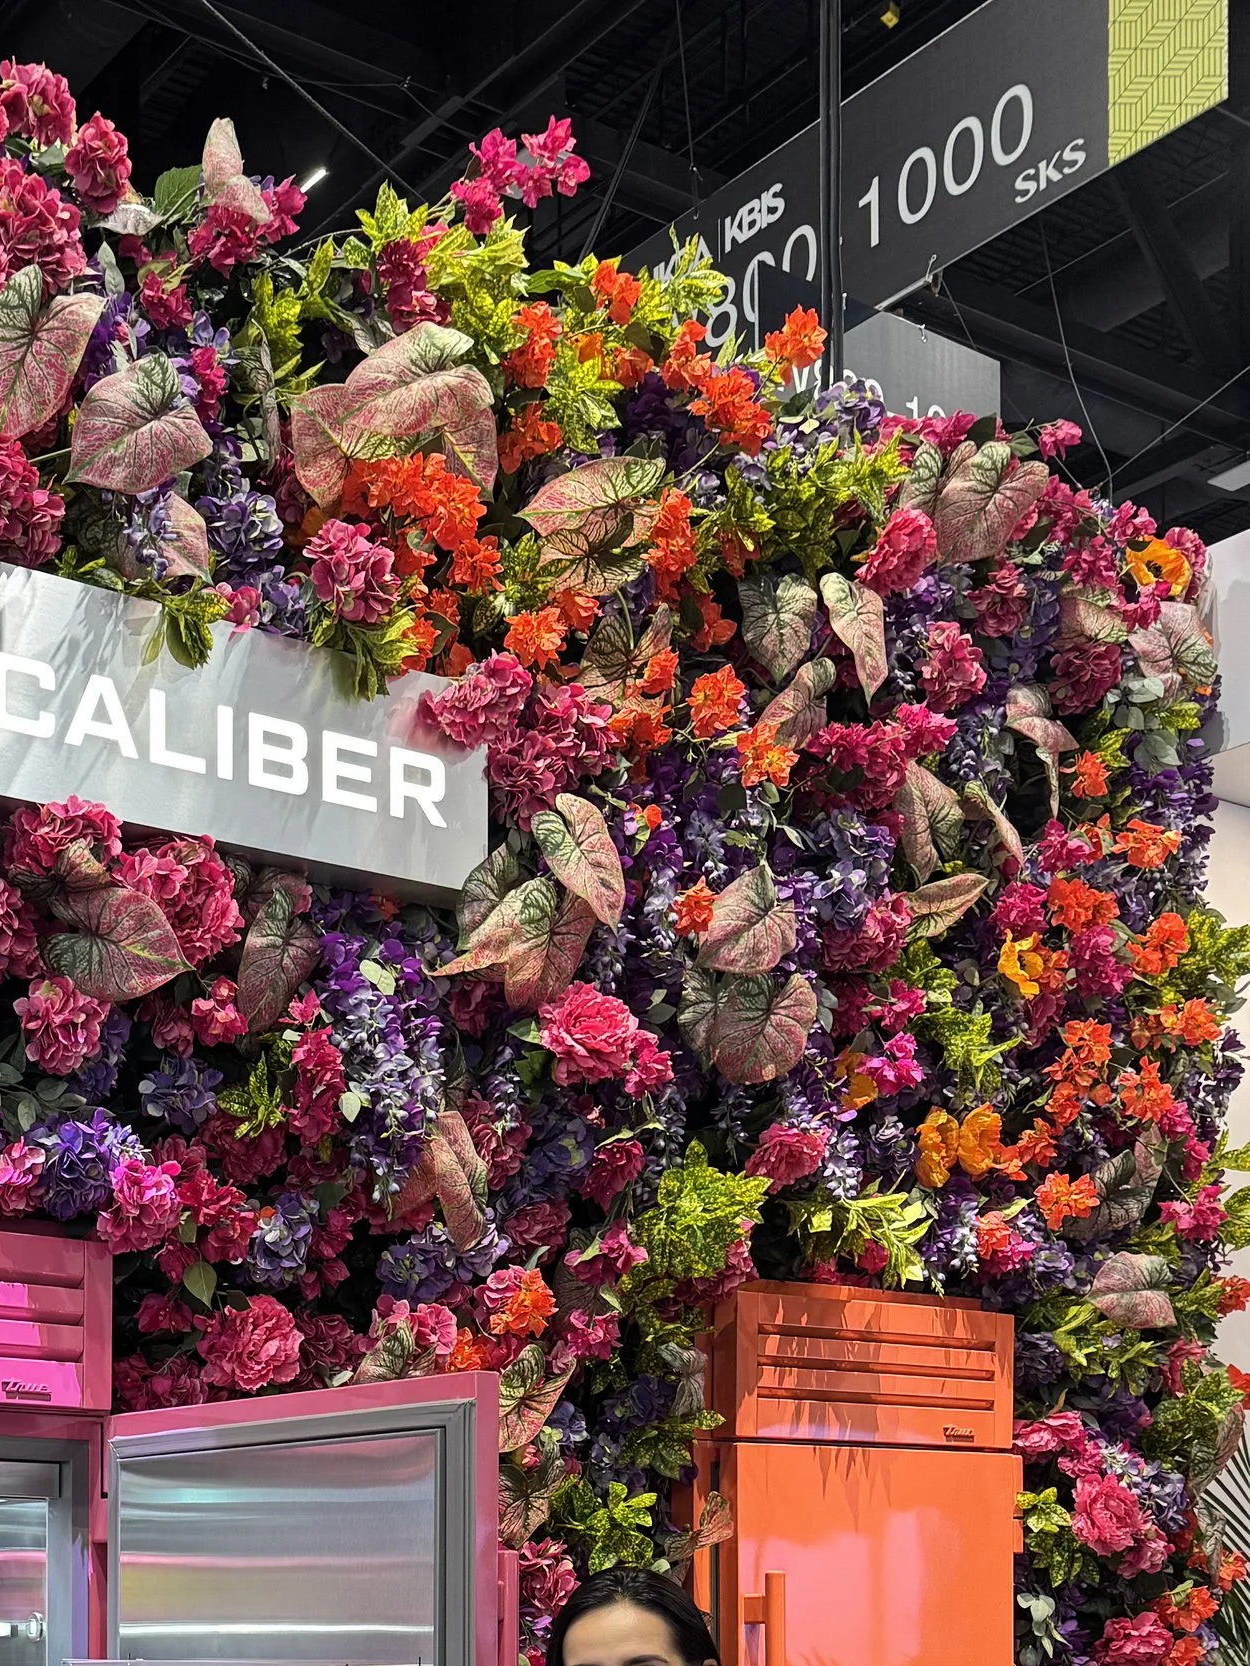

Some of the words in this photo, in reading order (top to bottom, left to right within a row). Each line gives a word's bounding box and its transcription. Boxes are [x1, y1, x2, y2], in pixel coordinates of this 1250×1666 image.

[858, 83, 1034, 249] 1000
[1014, 137, 1088, 204] SKS
[724, 182, 786, 255] KBIS
